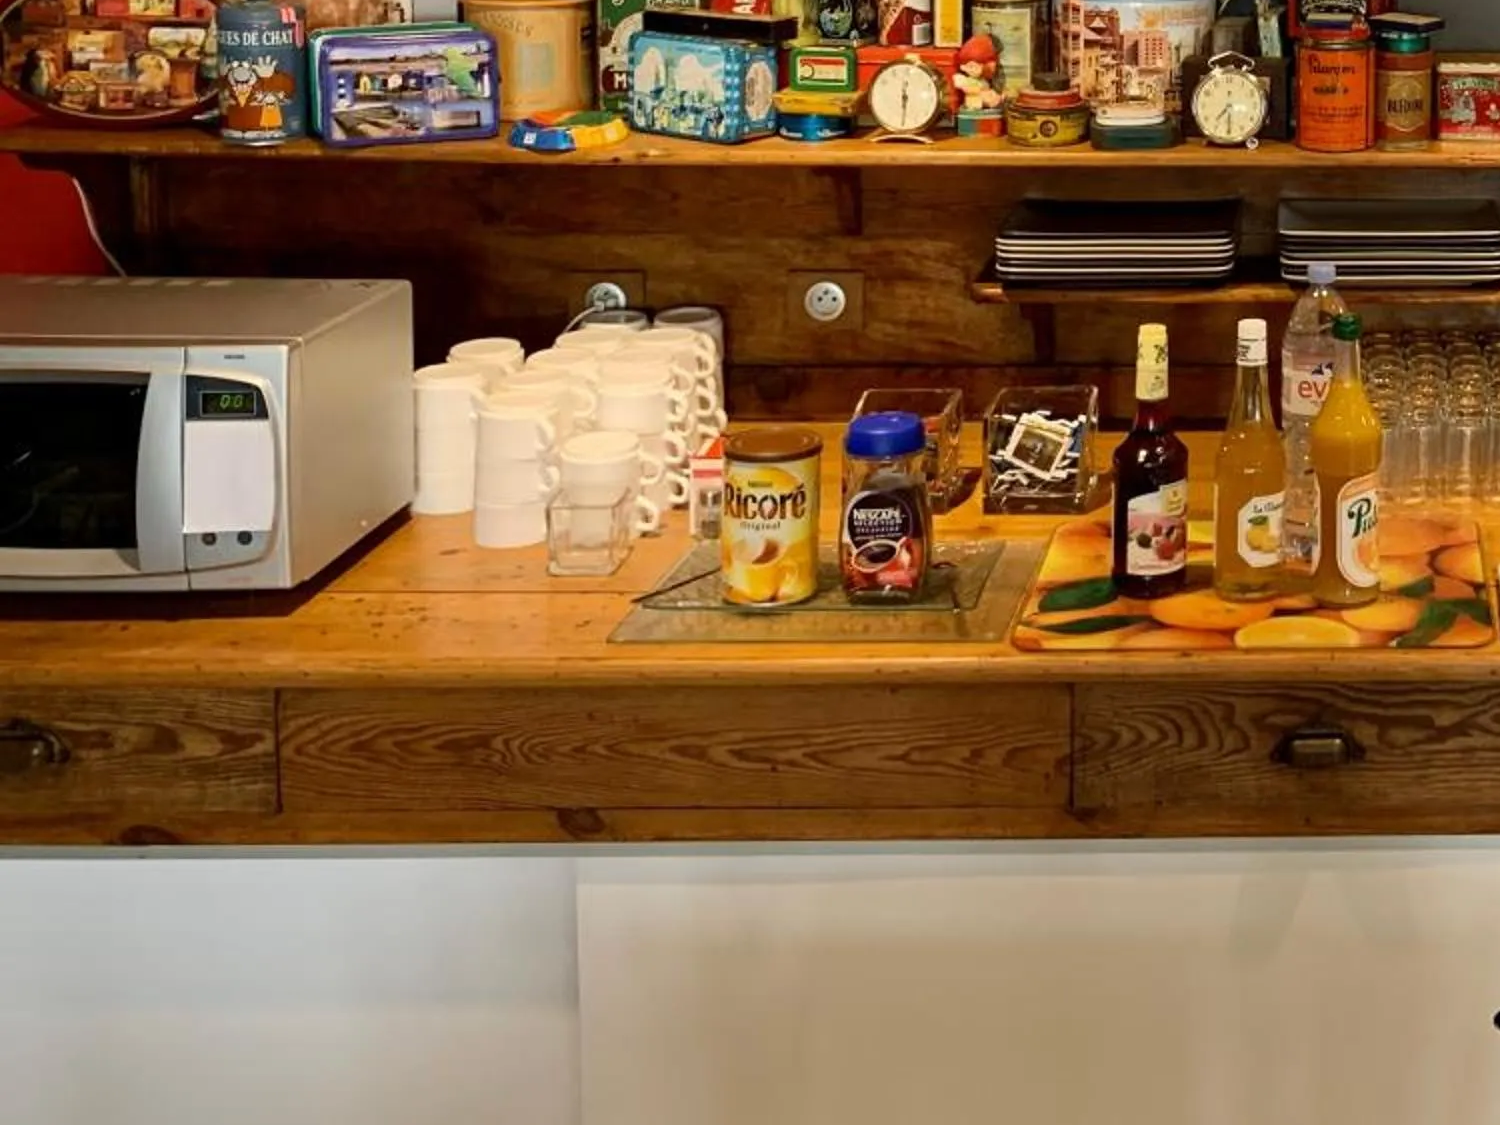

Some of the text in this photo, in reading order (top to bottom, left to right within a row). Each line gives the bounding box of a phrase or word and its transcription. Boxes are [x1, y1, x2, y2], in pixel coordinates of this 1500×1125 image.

[243, 31, 260, 46] DE
[263, 30, 294, 46] CHAT
[724, 482, 806, 520] Ricoré
